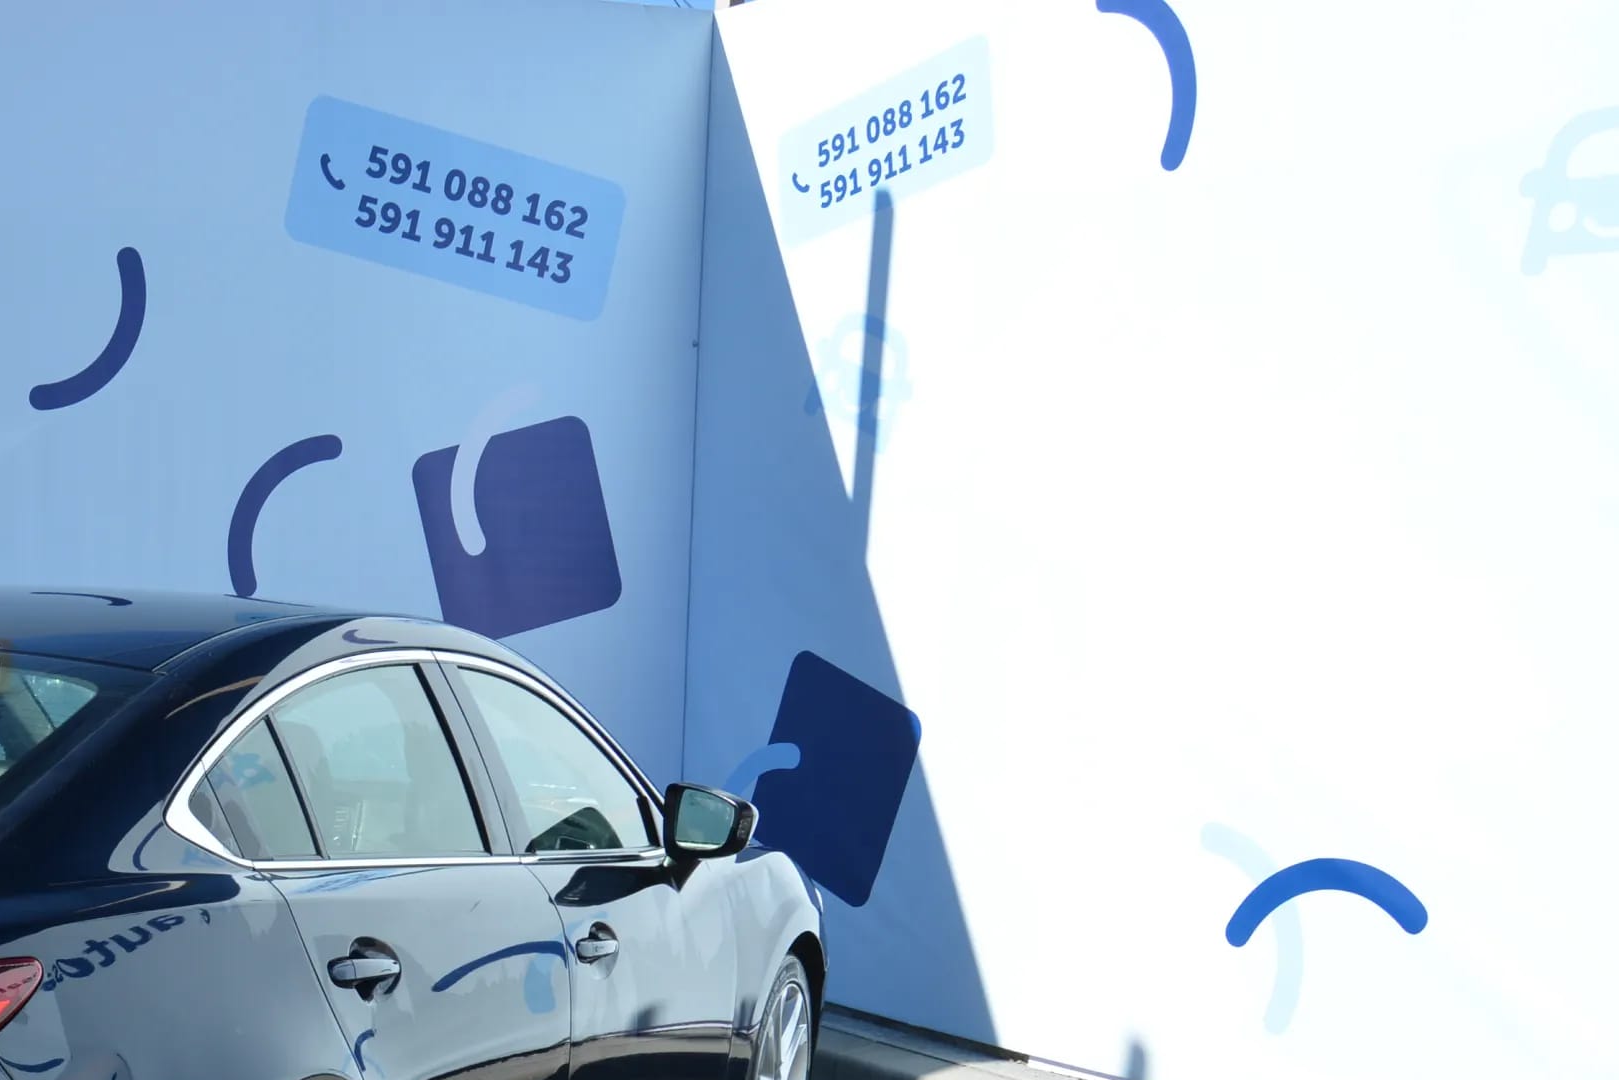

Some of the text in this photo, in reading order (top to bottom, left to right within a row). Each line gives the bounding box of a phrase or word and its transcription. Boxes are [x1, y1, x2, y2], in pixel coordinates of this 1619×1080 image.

[818, 73, 966, 168] 591 088 162
[820, 118, 965, 209] 591 911 143
[365, 145, 589, 239] 591 088 162
[355, 195, 574, 283] 591 911 143
